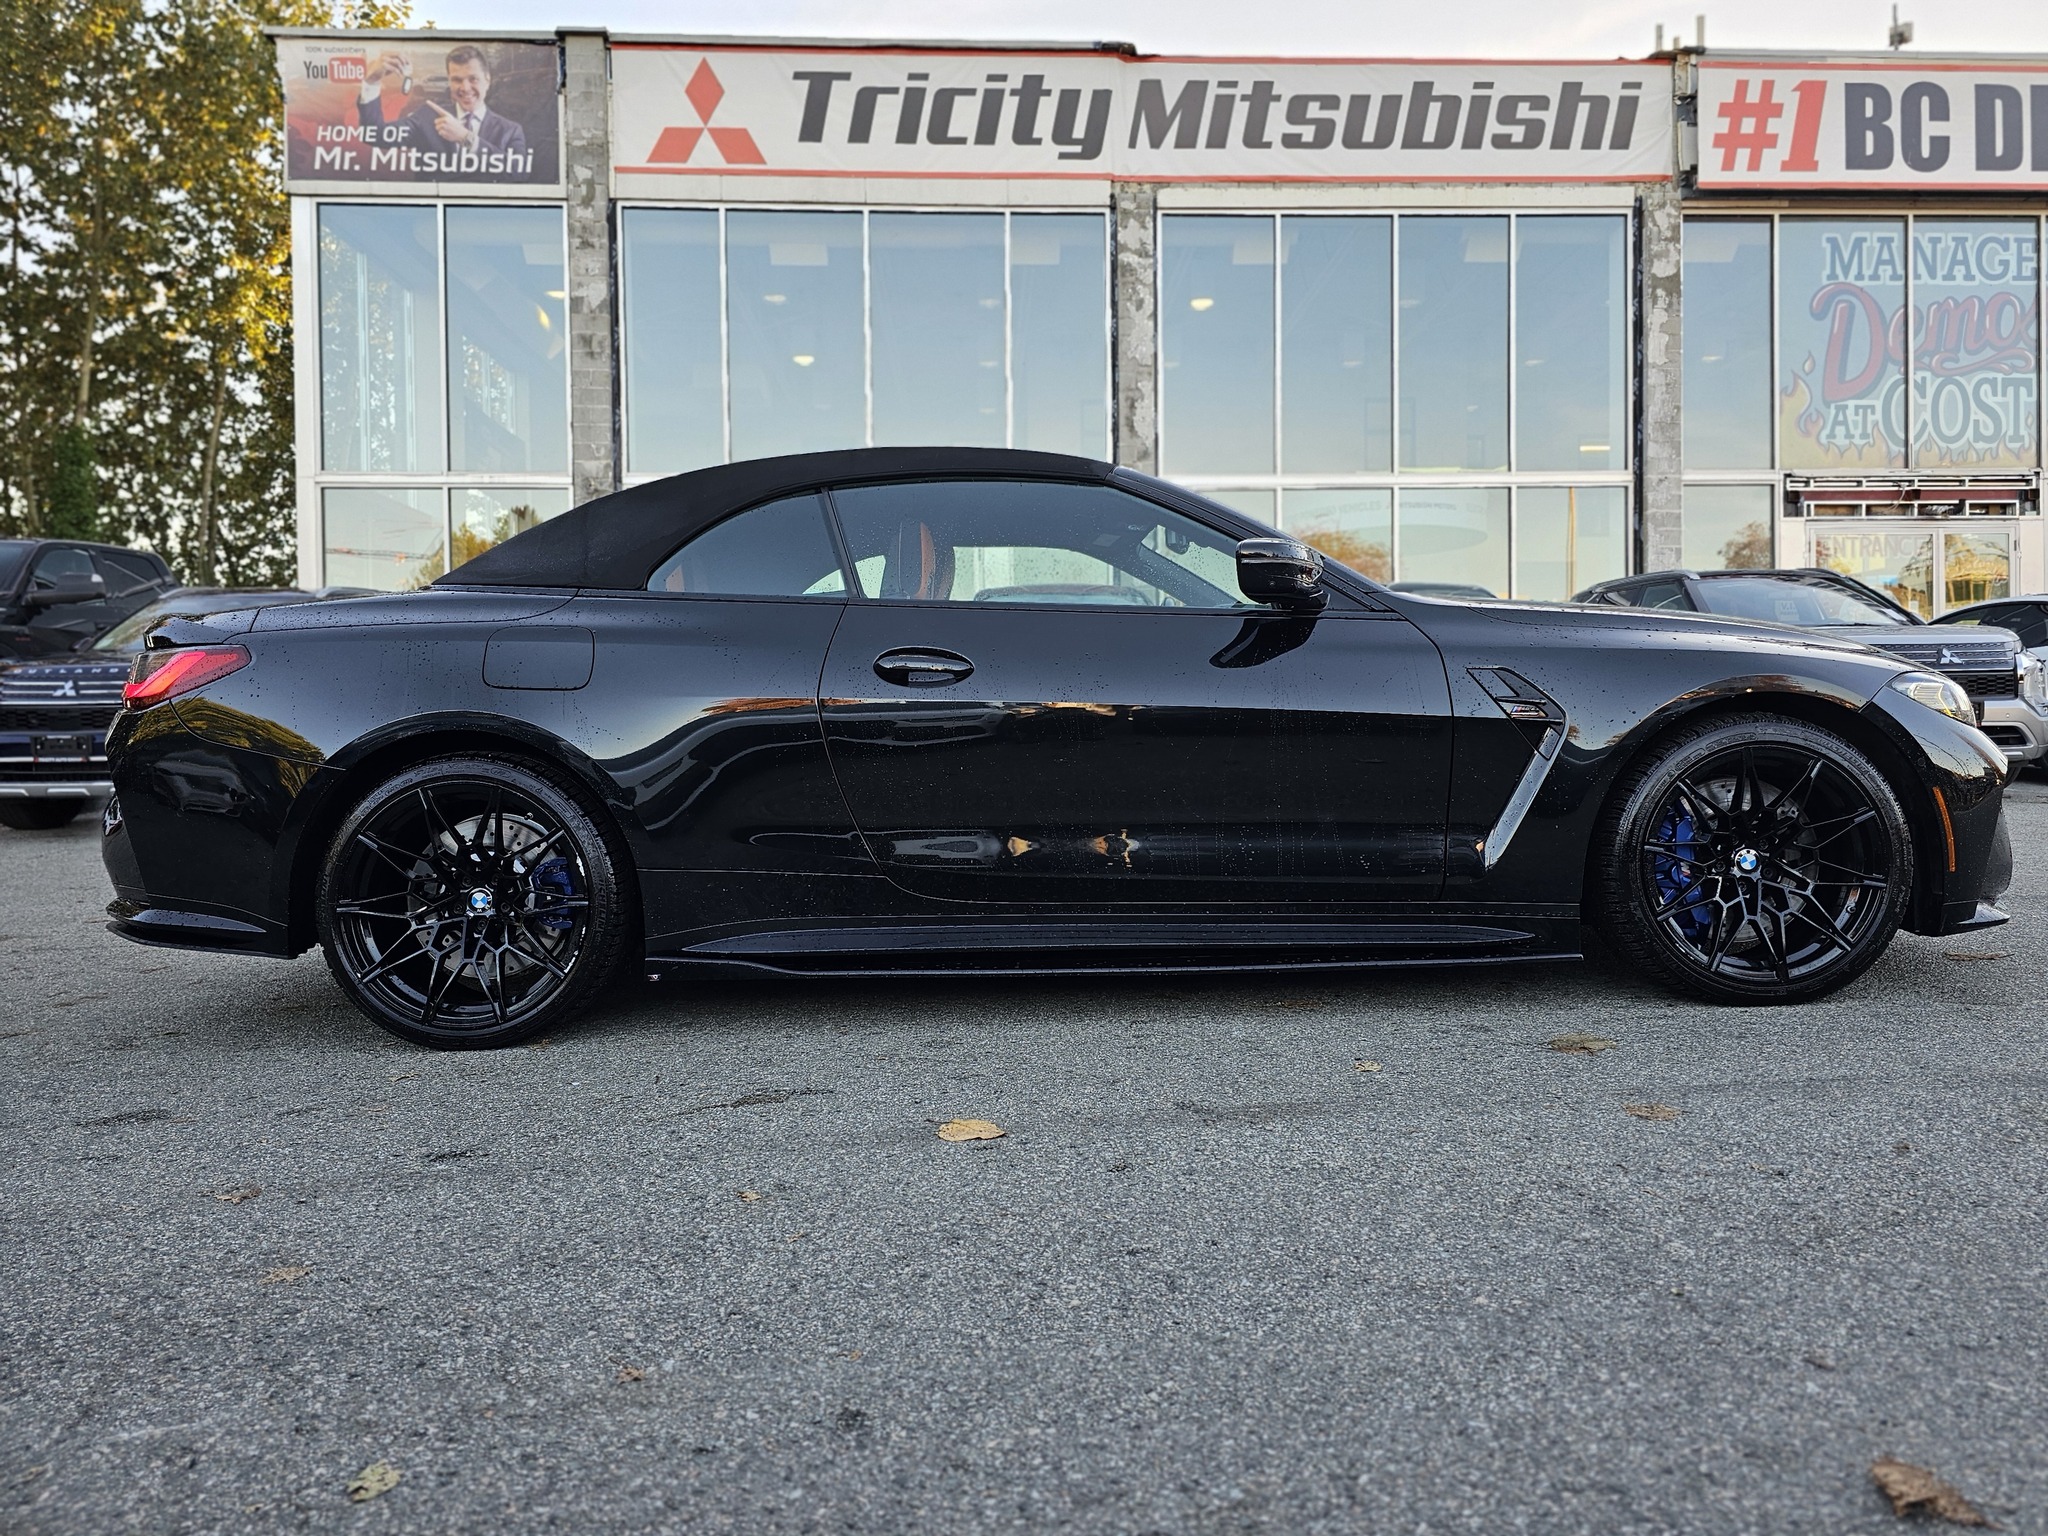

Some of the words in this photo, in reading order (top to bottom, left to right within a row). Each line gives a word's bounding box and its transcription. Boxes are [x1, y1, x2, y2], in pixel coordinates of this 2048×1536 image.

[316, 125, 377, 143] HOME
[383, 126, 410, 143] OF
[792, 71, 1113, 160] Tricity
[1128, 78, 1643, 151] Mitsubishi
[1712, 79, 1828, 172] #1
[1844, 81, 1951, 173] BC
[313, 146, 361, 171] Mr.
[370, 147, 534, 174] Mitsubishi
[1825, 235, 2040, 283] MANAGE
[1825, 403, 1876, 441] AT
[1881, 376, 2034, 449] COST
